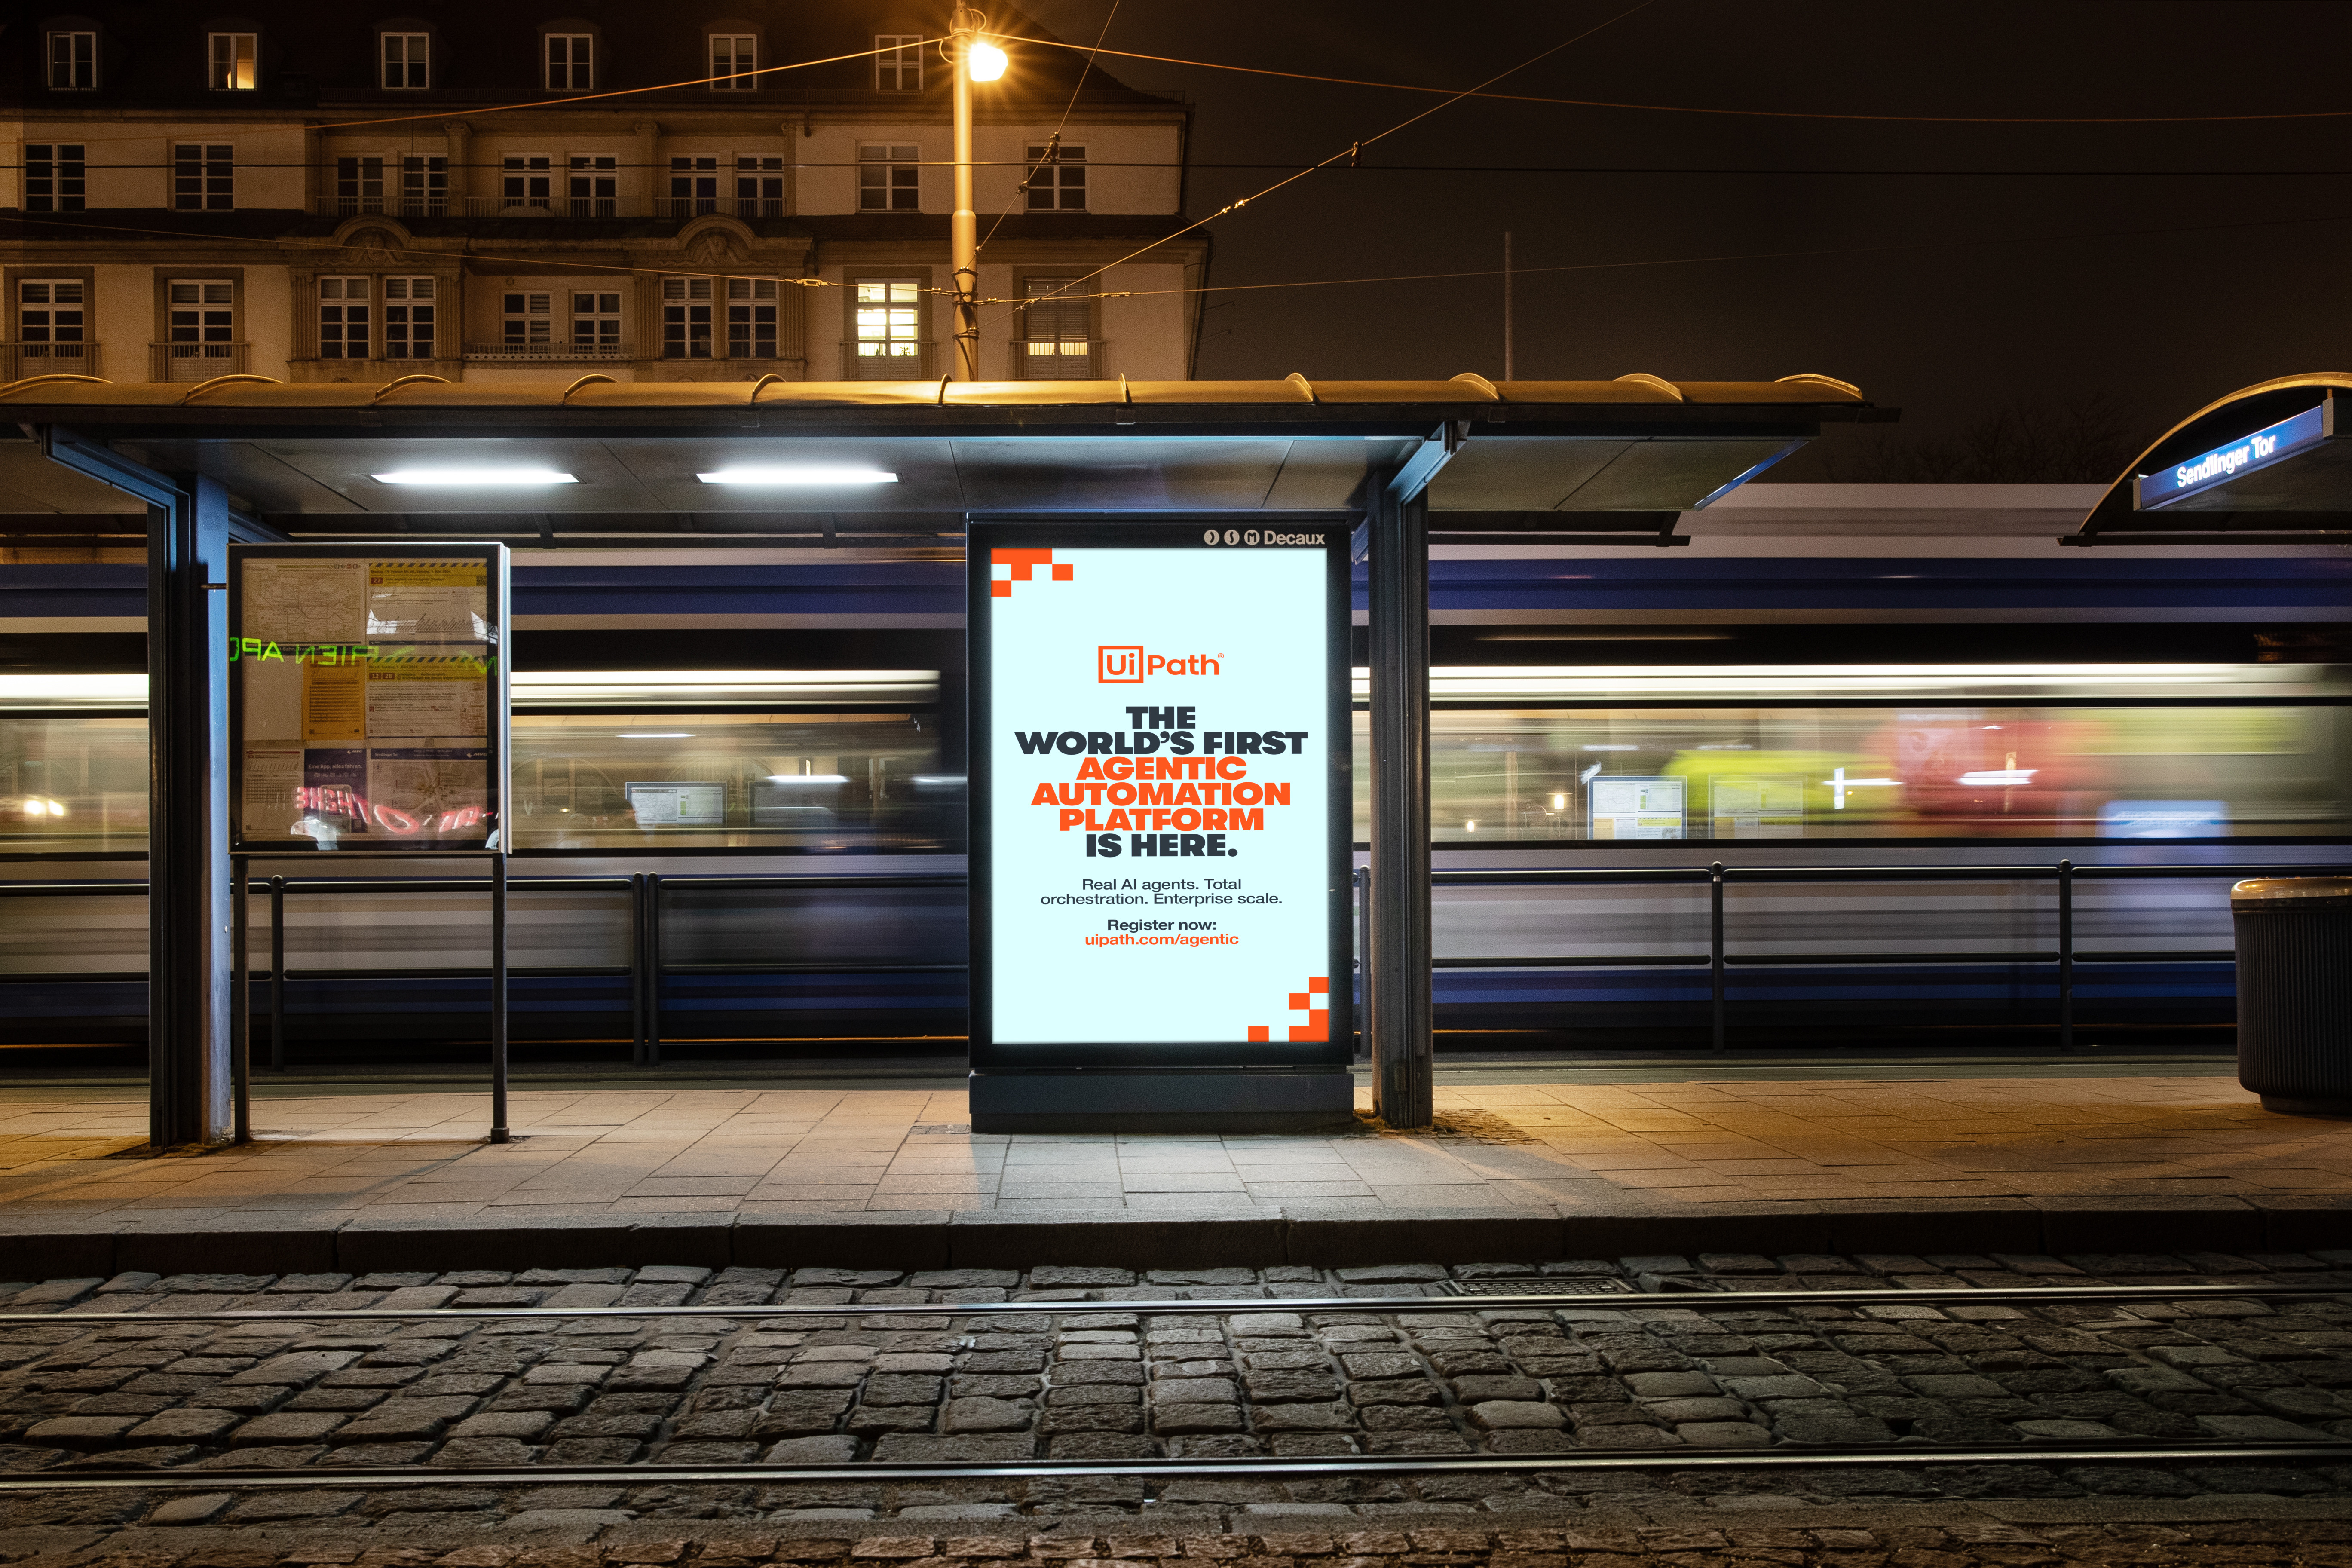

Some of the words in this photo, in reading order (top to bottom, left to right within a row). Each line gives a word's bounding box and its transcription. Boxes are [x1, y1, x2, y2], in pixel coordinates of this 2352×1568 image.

[2177, 444, 2250, 488] Sendlinger
[2251, 434, 2277, 459] Tor
[1264, 530, 1326, 545] Decaux
[1126, 706, 1195, 729] THE
[1204, 731, 1308, 755] FIRST
[1076, 756, 1247, 781] AGENTIC
[1031, 782, 1290, 806] AUTOMATION
[1060, 808, 1264, 831] PLATFORM
[1087, 833, 1122, 858] IS
[1131, 834, 1237, 857] HERE.
[1083, 879, 1116, 890] Real
[1121, 879, 1136, 890] AI
[1142, 879, 1199, 892] agents.
[1204, 879, 1241, 889] Total
[1041, 894, 1148, 904] orchestration.
[1154, 893, 1233, 906] Enterprise
[1238, 893, 1282, 904] scale.
[1108, 919, 1174, 933] Register
[1179, 922, 1216, 930] now:
[1086, 934, 1239, 947] uipath.com/agentic
